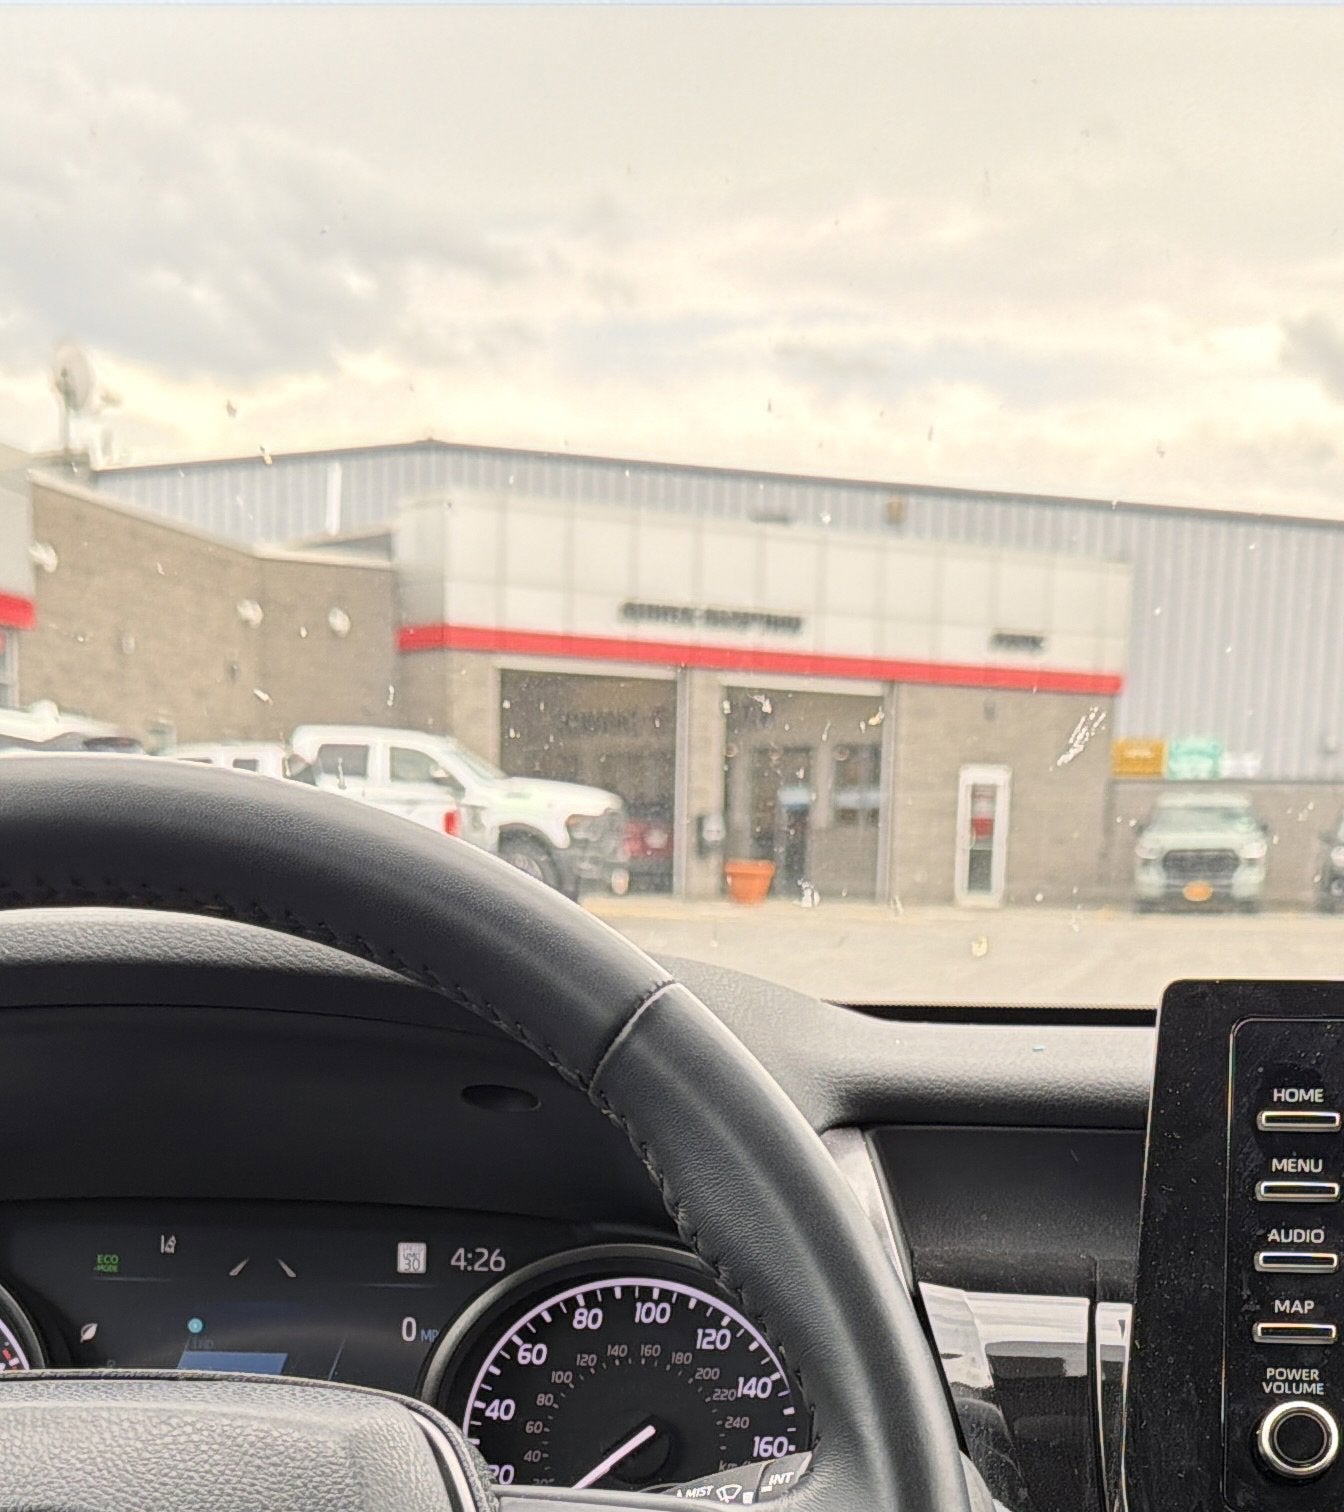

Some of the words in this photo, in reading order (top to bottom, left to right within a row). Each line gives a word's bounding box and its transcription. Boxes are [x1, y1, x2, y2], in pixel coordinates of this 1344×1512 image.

[1273, 1088, 1324, 1102] HOME
[1271, 1158, 1323, 1173] MENU
[1267, 1229, 1325, 1244] AUDIO
[97, 1254, 119, 1264] ECO
[404, 1259, 421, 1271] 30
[450, 1247, 506, 1272] 4:26
[635, 1302, 671, 1324] 100
[1274, 1299, 1315, 1314] MAP
[572, 1308, 603, 1330] 80
[401, 1316, 417, 1342] 0
[696, 1328, 731, 1351] 120
[517, 1343, 548, 1366] 60
[607, 1344, 628, 1357] 140
[640, 1344, 661, 1357] 160
[576, 1354, 598, 1367] 120
[671, 1352, 693, 1365] 180
[551, 1371, 573, 1384] 100
[694, 1367, 720, 1381] 200
[1266, 1367, 1320, 1381] POWER
[737, 1376, 773, 1399] 140
[1262, 1381, 1325, 1395] VOLUME
[536, 1393, 554, 1407] 80
[712, 1388, 737, 1402] 220
[485, 1399, 516, 1421] 40
[525, 1421, 544, 1434] 60
[725, 1416, 750, 1429] 240
[753, 1436, 789, 1458] 160
[523, 1450, 542, 1463] 40
[685, 1485, 714, 1498] MIST
